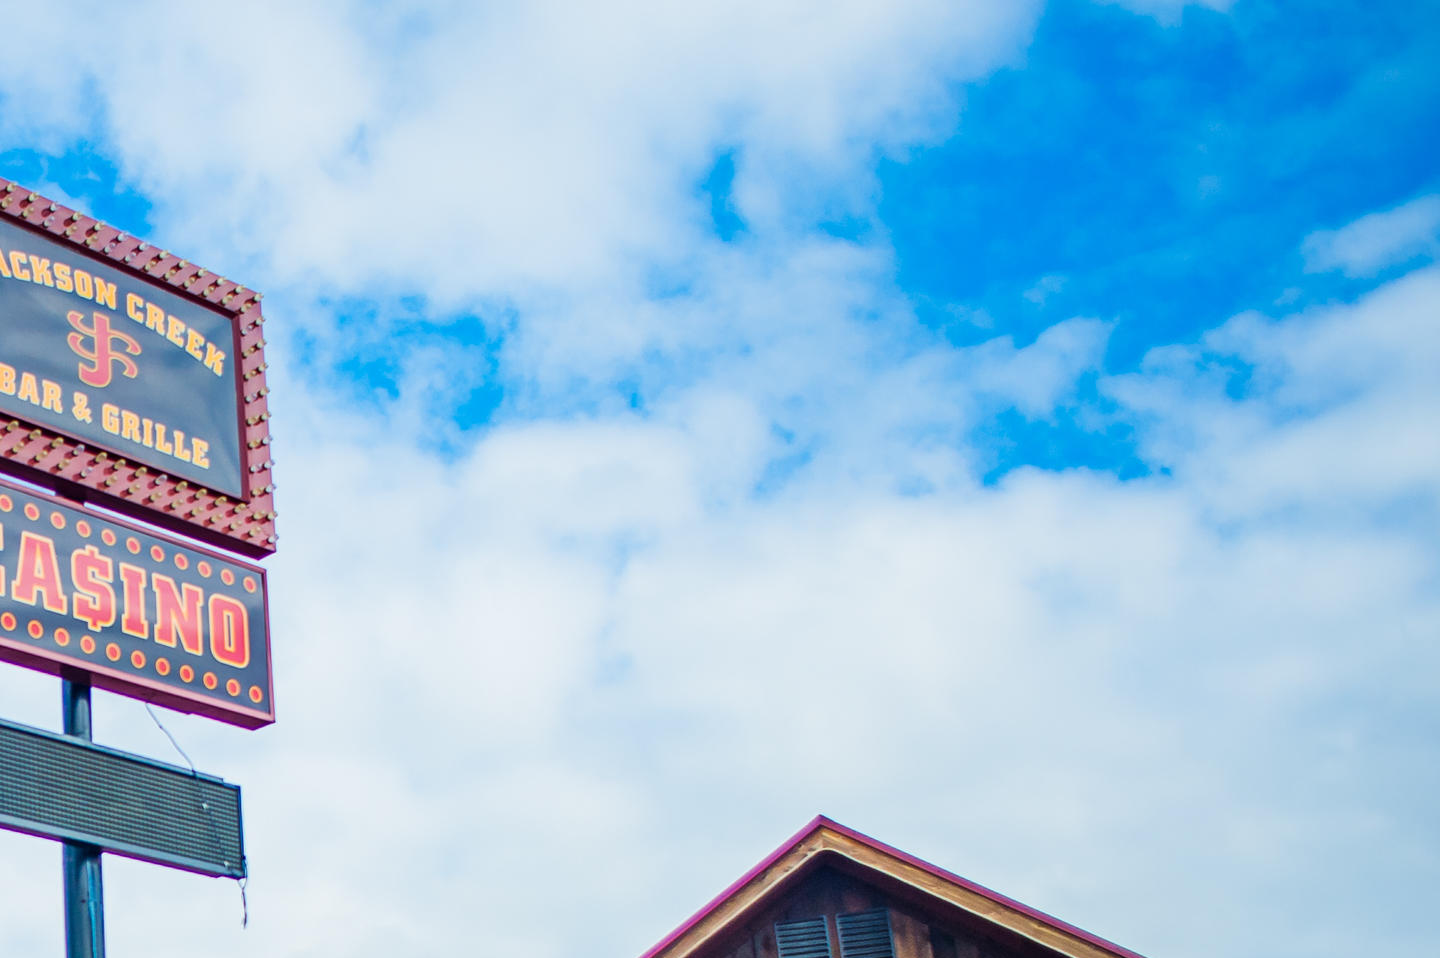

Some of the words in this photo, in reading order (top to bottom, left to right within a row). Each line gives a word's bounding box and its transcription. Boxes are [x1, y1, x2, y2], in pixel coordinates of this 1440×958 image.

[126, 292, 226, 377] CREEK
[72, 391, 93, 424] &
[101, 402, 211, 470] GRILLE
